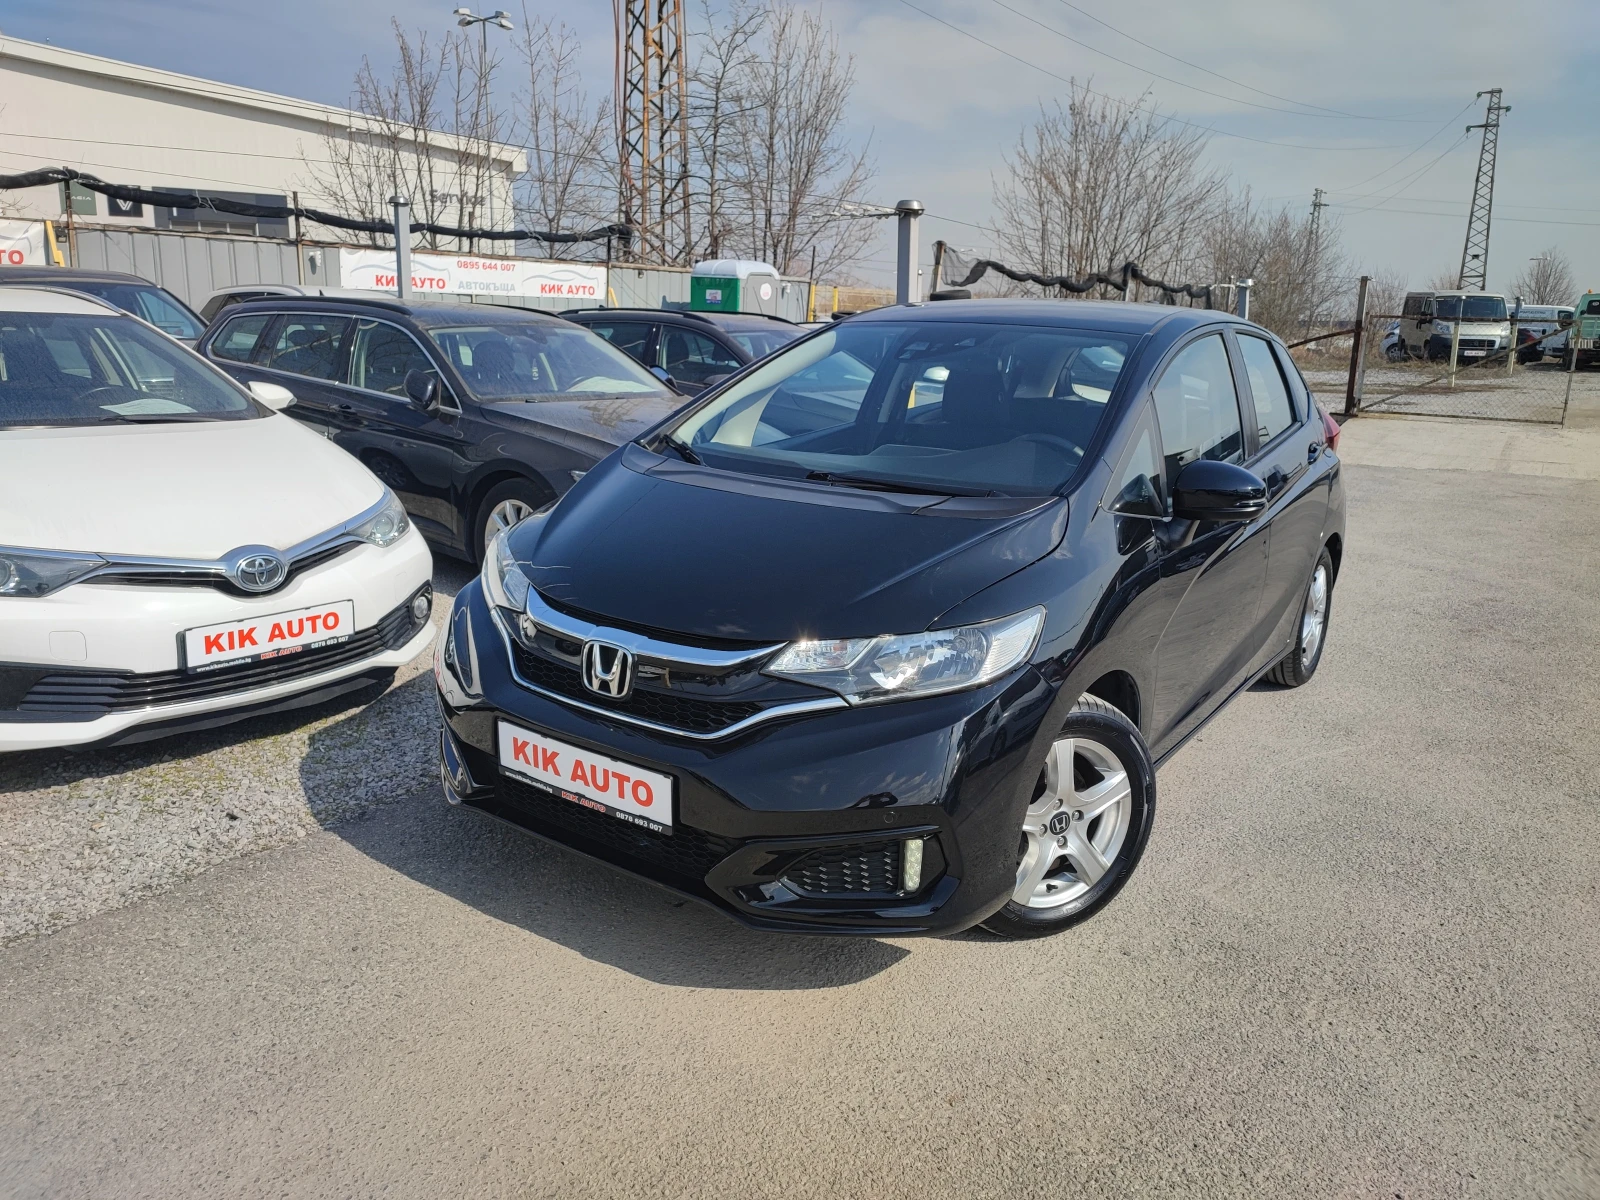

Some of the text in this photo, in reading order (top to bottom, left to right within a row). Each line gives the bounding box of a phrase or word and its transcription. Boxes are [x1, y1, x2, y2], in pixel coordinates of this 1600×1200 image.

[457, 260, 516, 272] 0895 644 007
[375, 274, 401, 288] КИ
[457, 280, 516, 293] АВТОКЪЩА
[540, 283, 596, 296] КИК АУТО
[204, 611, 340, 655] KIK AUTO
[278, 645, 303, 656] AUTO
[512, 736, 562, 777] KIK
[570, 759, 654, 808] AUTO
[561, 790, 606, 813] KIK AUTO
[615, 811, 633, 822] 0878
[649, 823, 663, 832] 007
